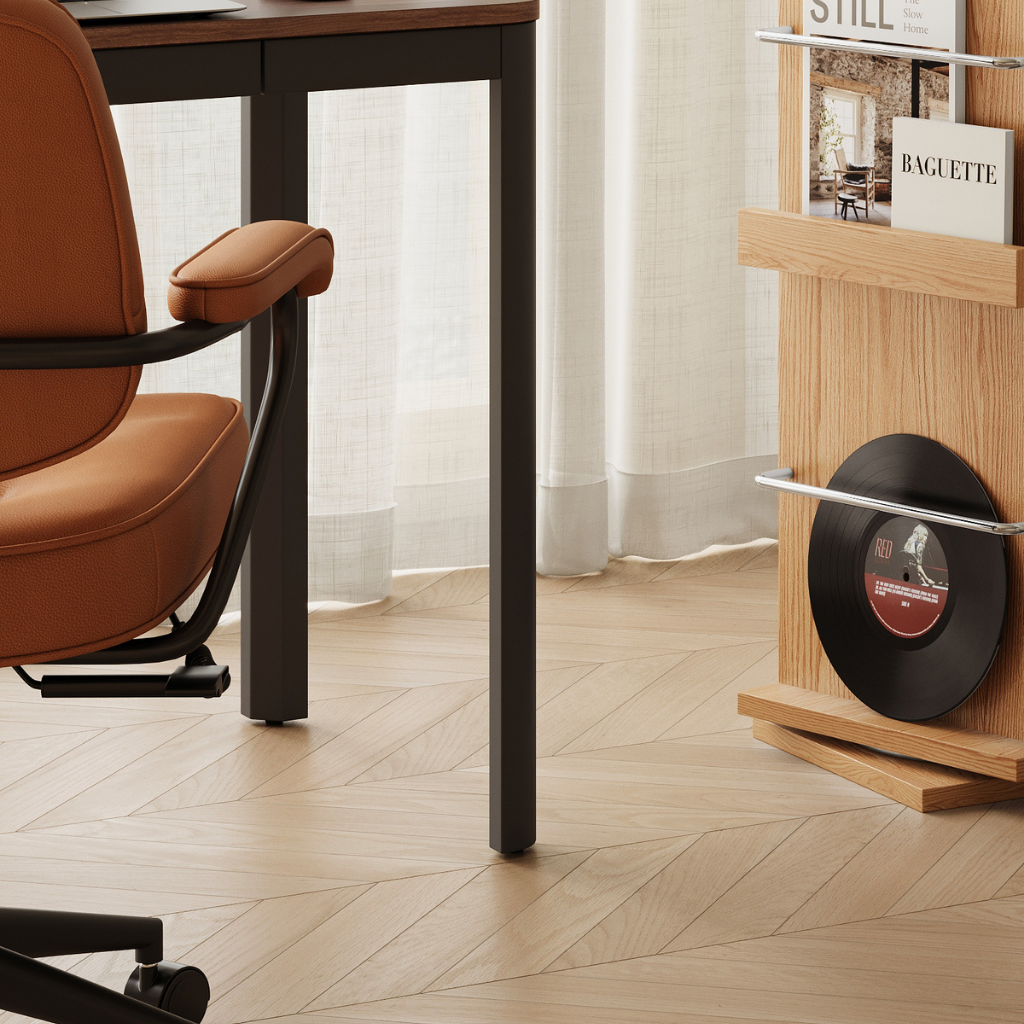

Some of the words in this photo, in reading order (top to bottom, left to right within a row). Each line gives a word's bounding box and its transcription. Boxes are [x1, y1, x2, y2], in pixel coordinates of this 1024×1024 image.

[903, 8, 924, 20] Slow
[903, 22, 929, 35] Home
[901, 153, 997, 185] BAGUETTE
[875, 537, 893, 559] RED
